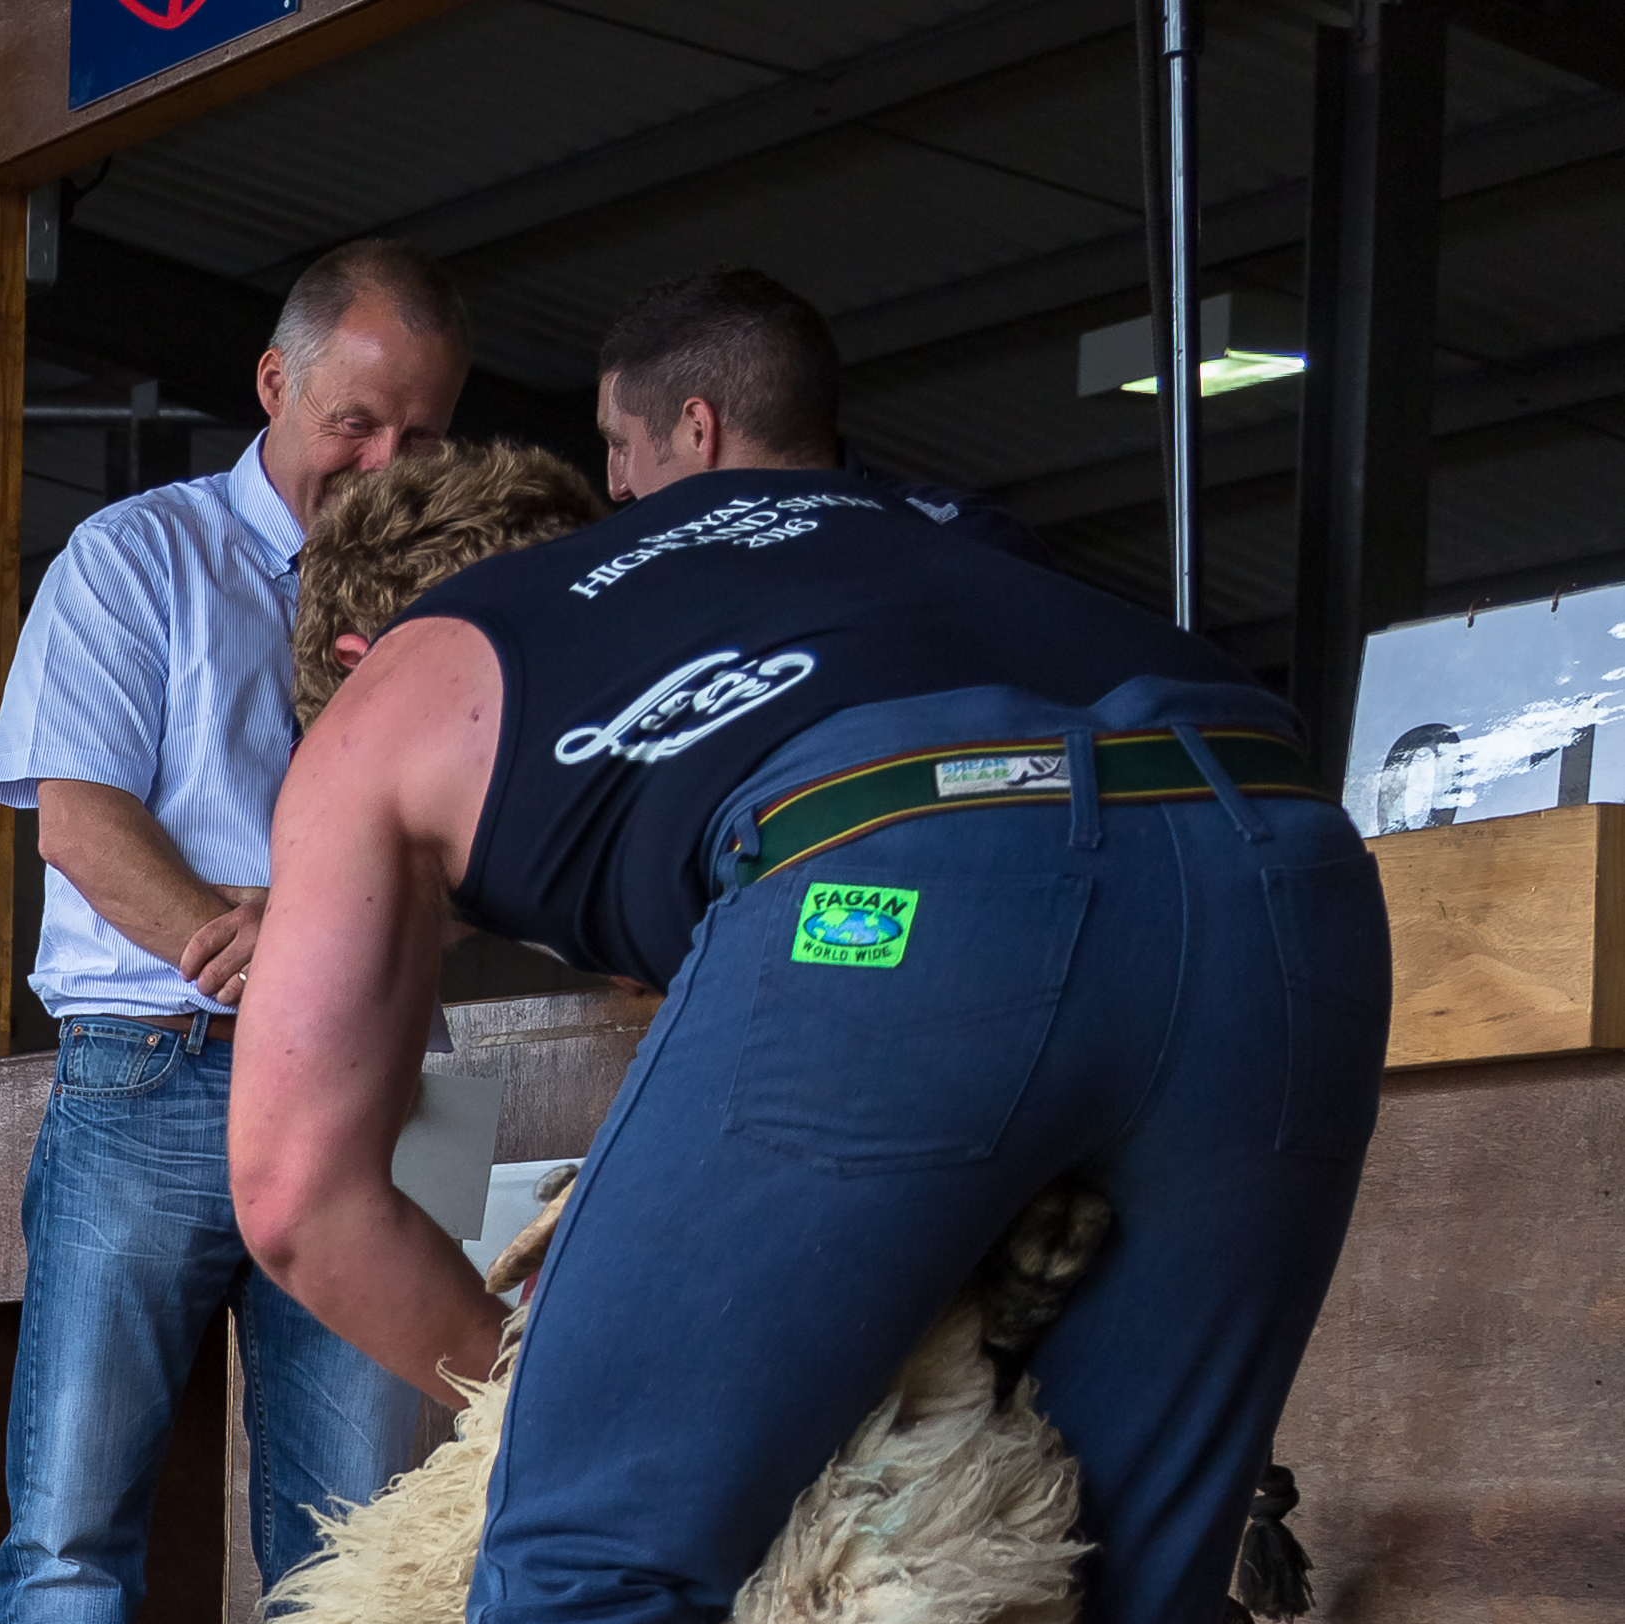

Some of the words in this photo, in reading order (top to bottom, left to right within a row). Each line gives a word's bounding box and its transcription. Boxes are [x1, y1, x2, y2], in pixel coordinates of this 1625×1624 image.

[732, 517, 818, 549] 2016
[813, 889, 908, 917] FAGAN
[803, 940, 849, 962] WORLD
[855, 945, 893, 962] WIDE
